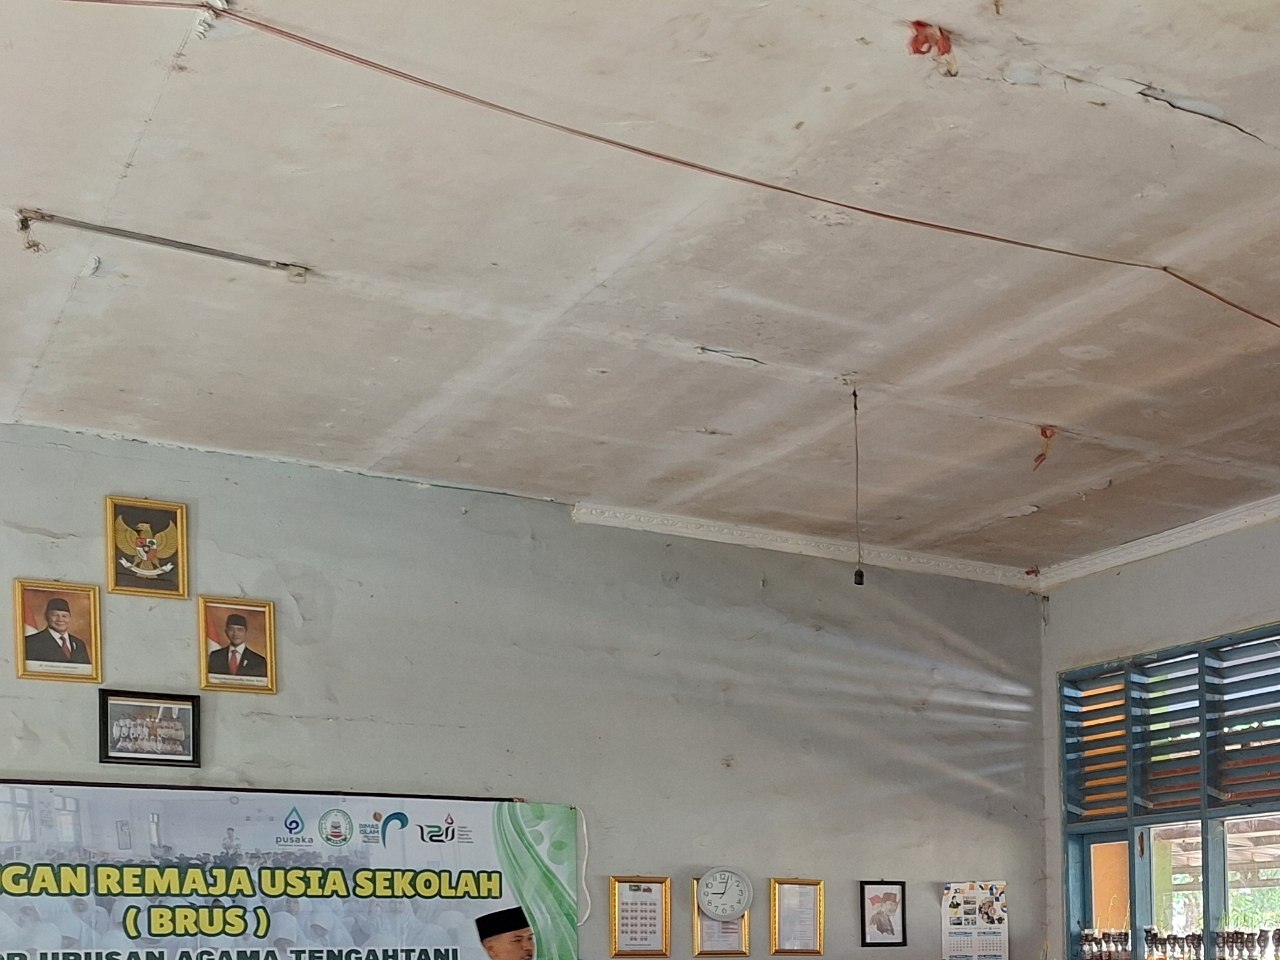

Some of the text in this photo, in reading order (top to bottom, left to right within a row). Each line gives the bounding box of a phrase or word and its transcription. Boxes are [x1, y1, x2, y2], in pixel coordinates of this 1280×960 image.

[275, 836, 314, 846] pusaka
[95, 865, 255, 897] REMAJA
[260, 867, 349, 897] USIA
[353, 869, 502, 899] SEKOLAH
[149, 906, 247, 935] BRUS
